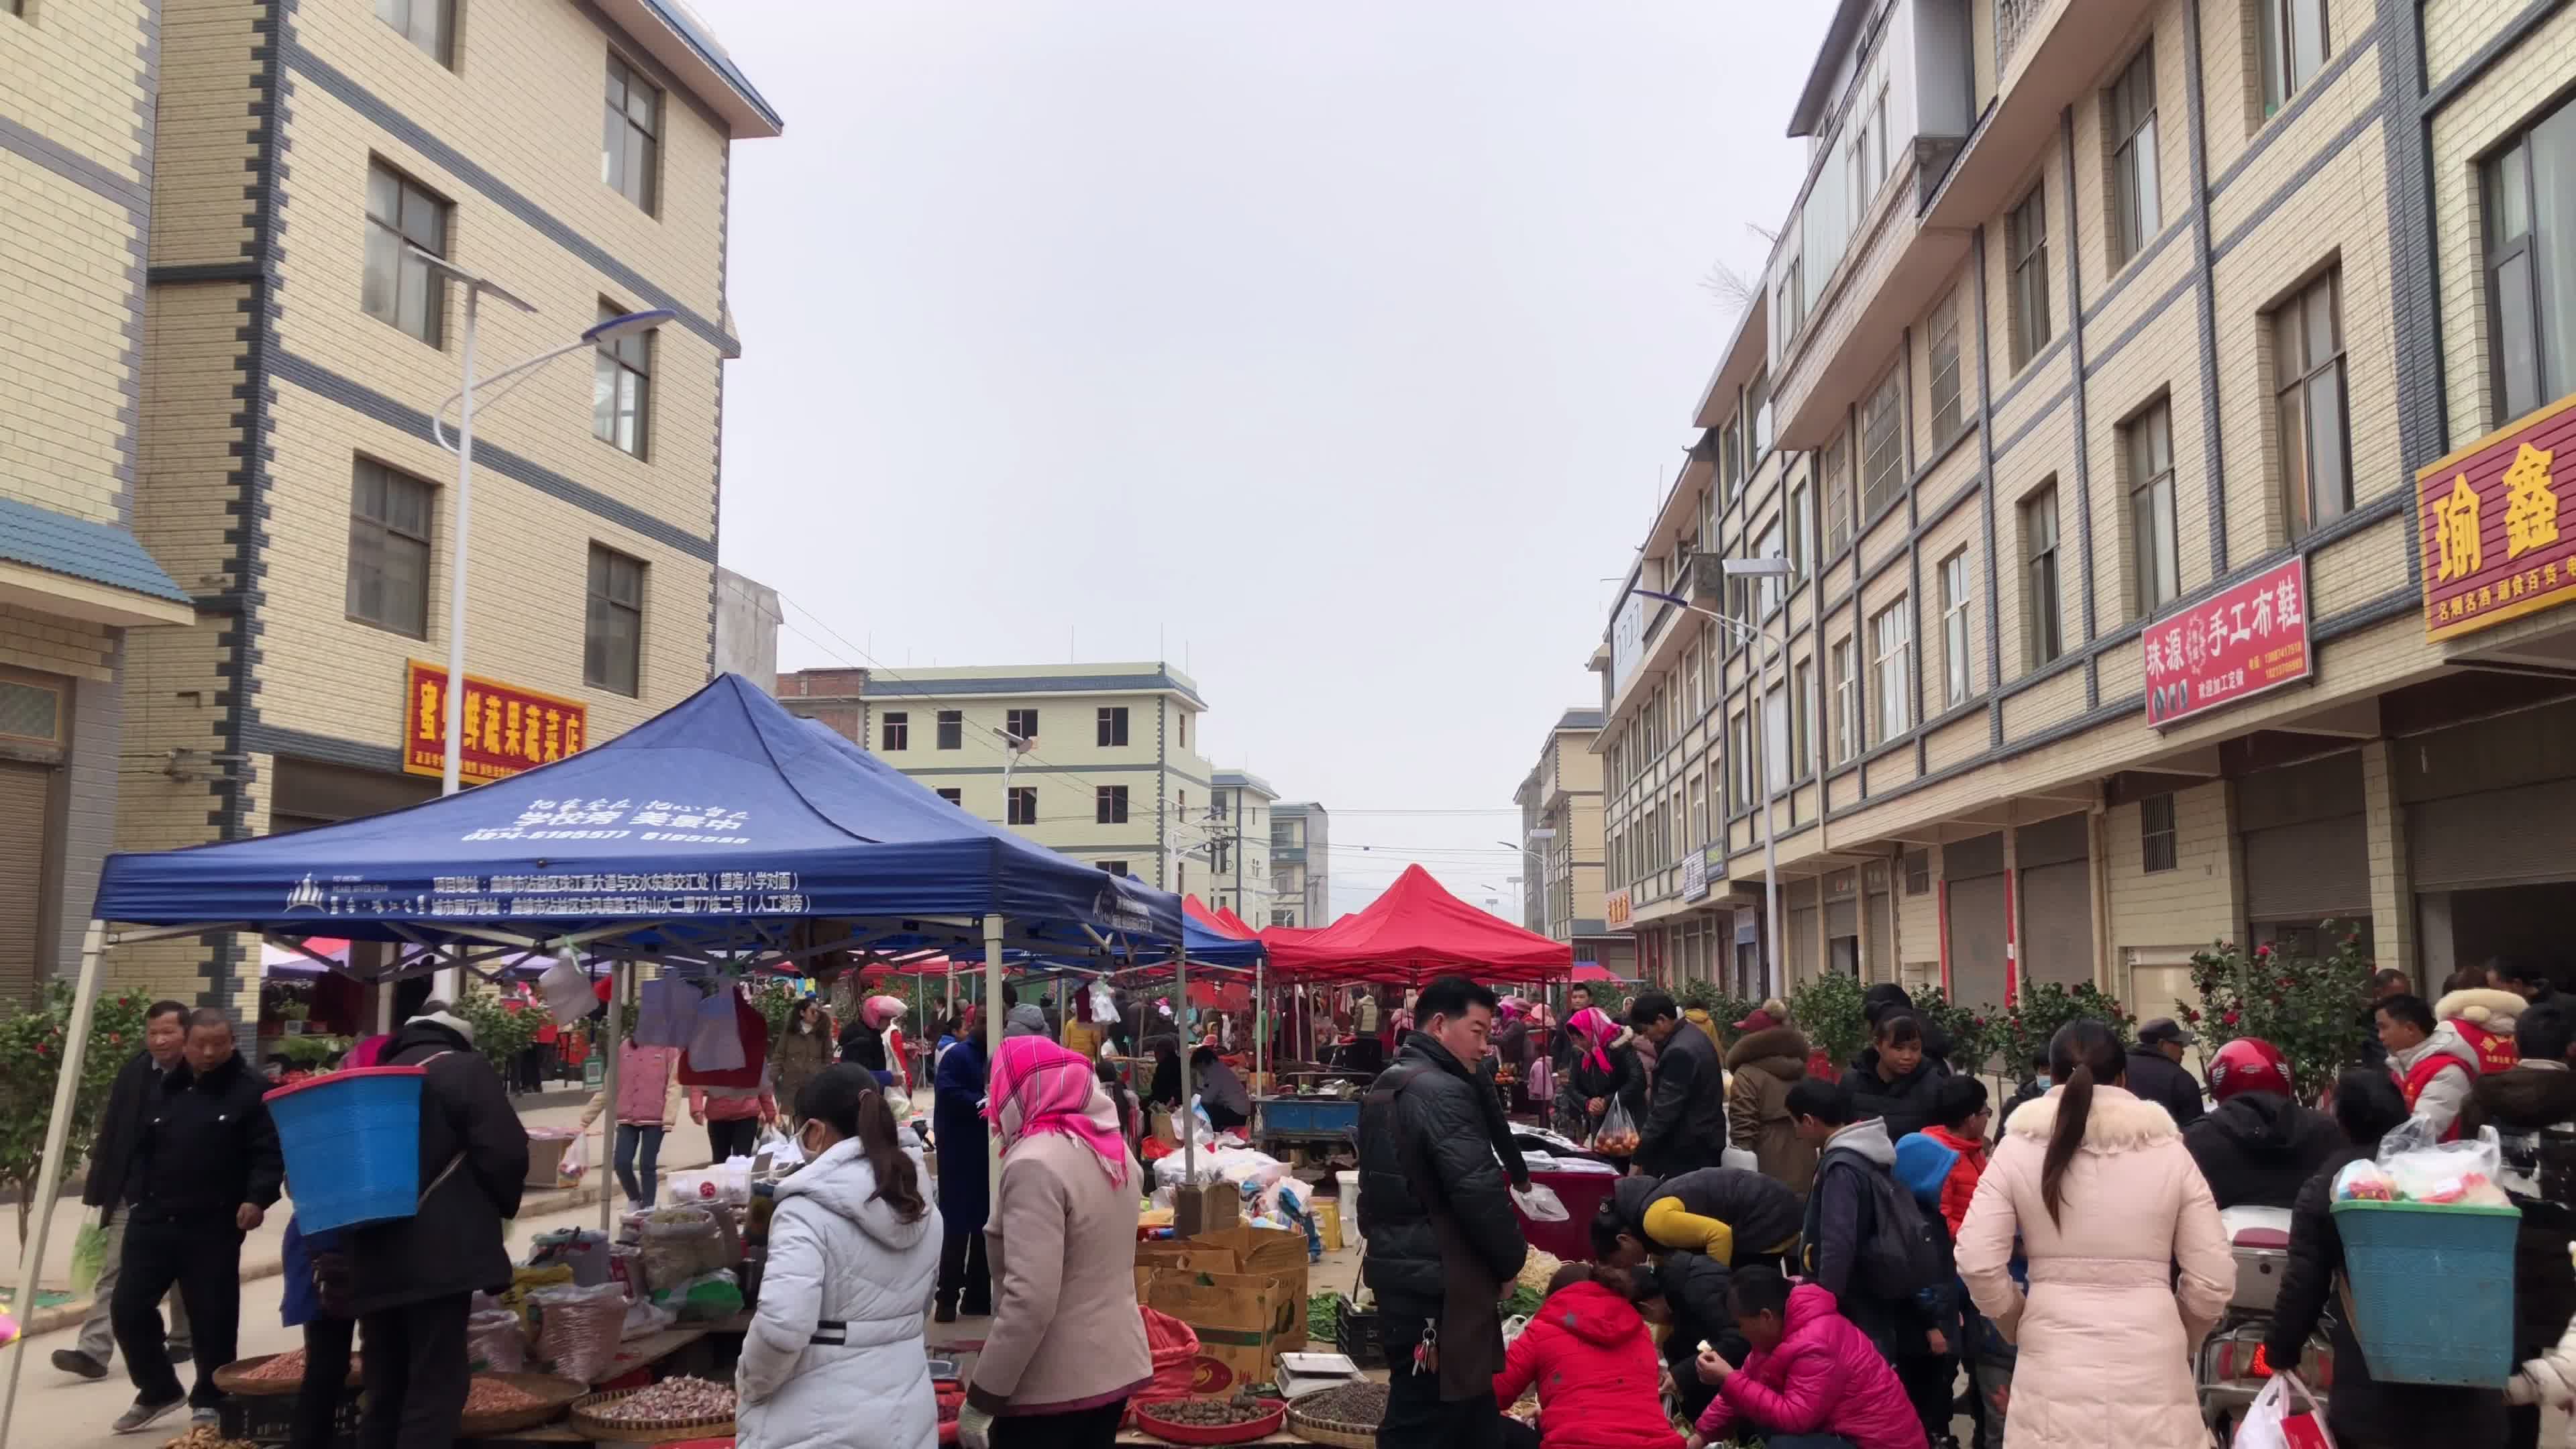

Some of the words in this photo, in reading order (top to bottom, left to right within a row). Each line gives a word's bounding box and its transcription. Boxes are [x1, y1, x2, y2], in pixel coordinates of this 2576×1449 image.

[2433, 443, 2559, 582] 瑜鑫
[2208, 575, 2302, 657] 手工布鞋
[513, 812, 623, 827] 学校旁
[629, 811, 743, 830] 美景中
